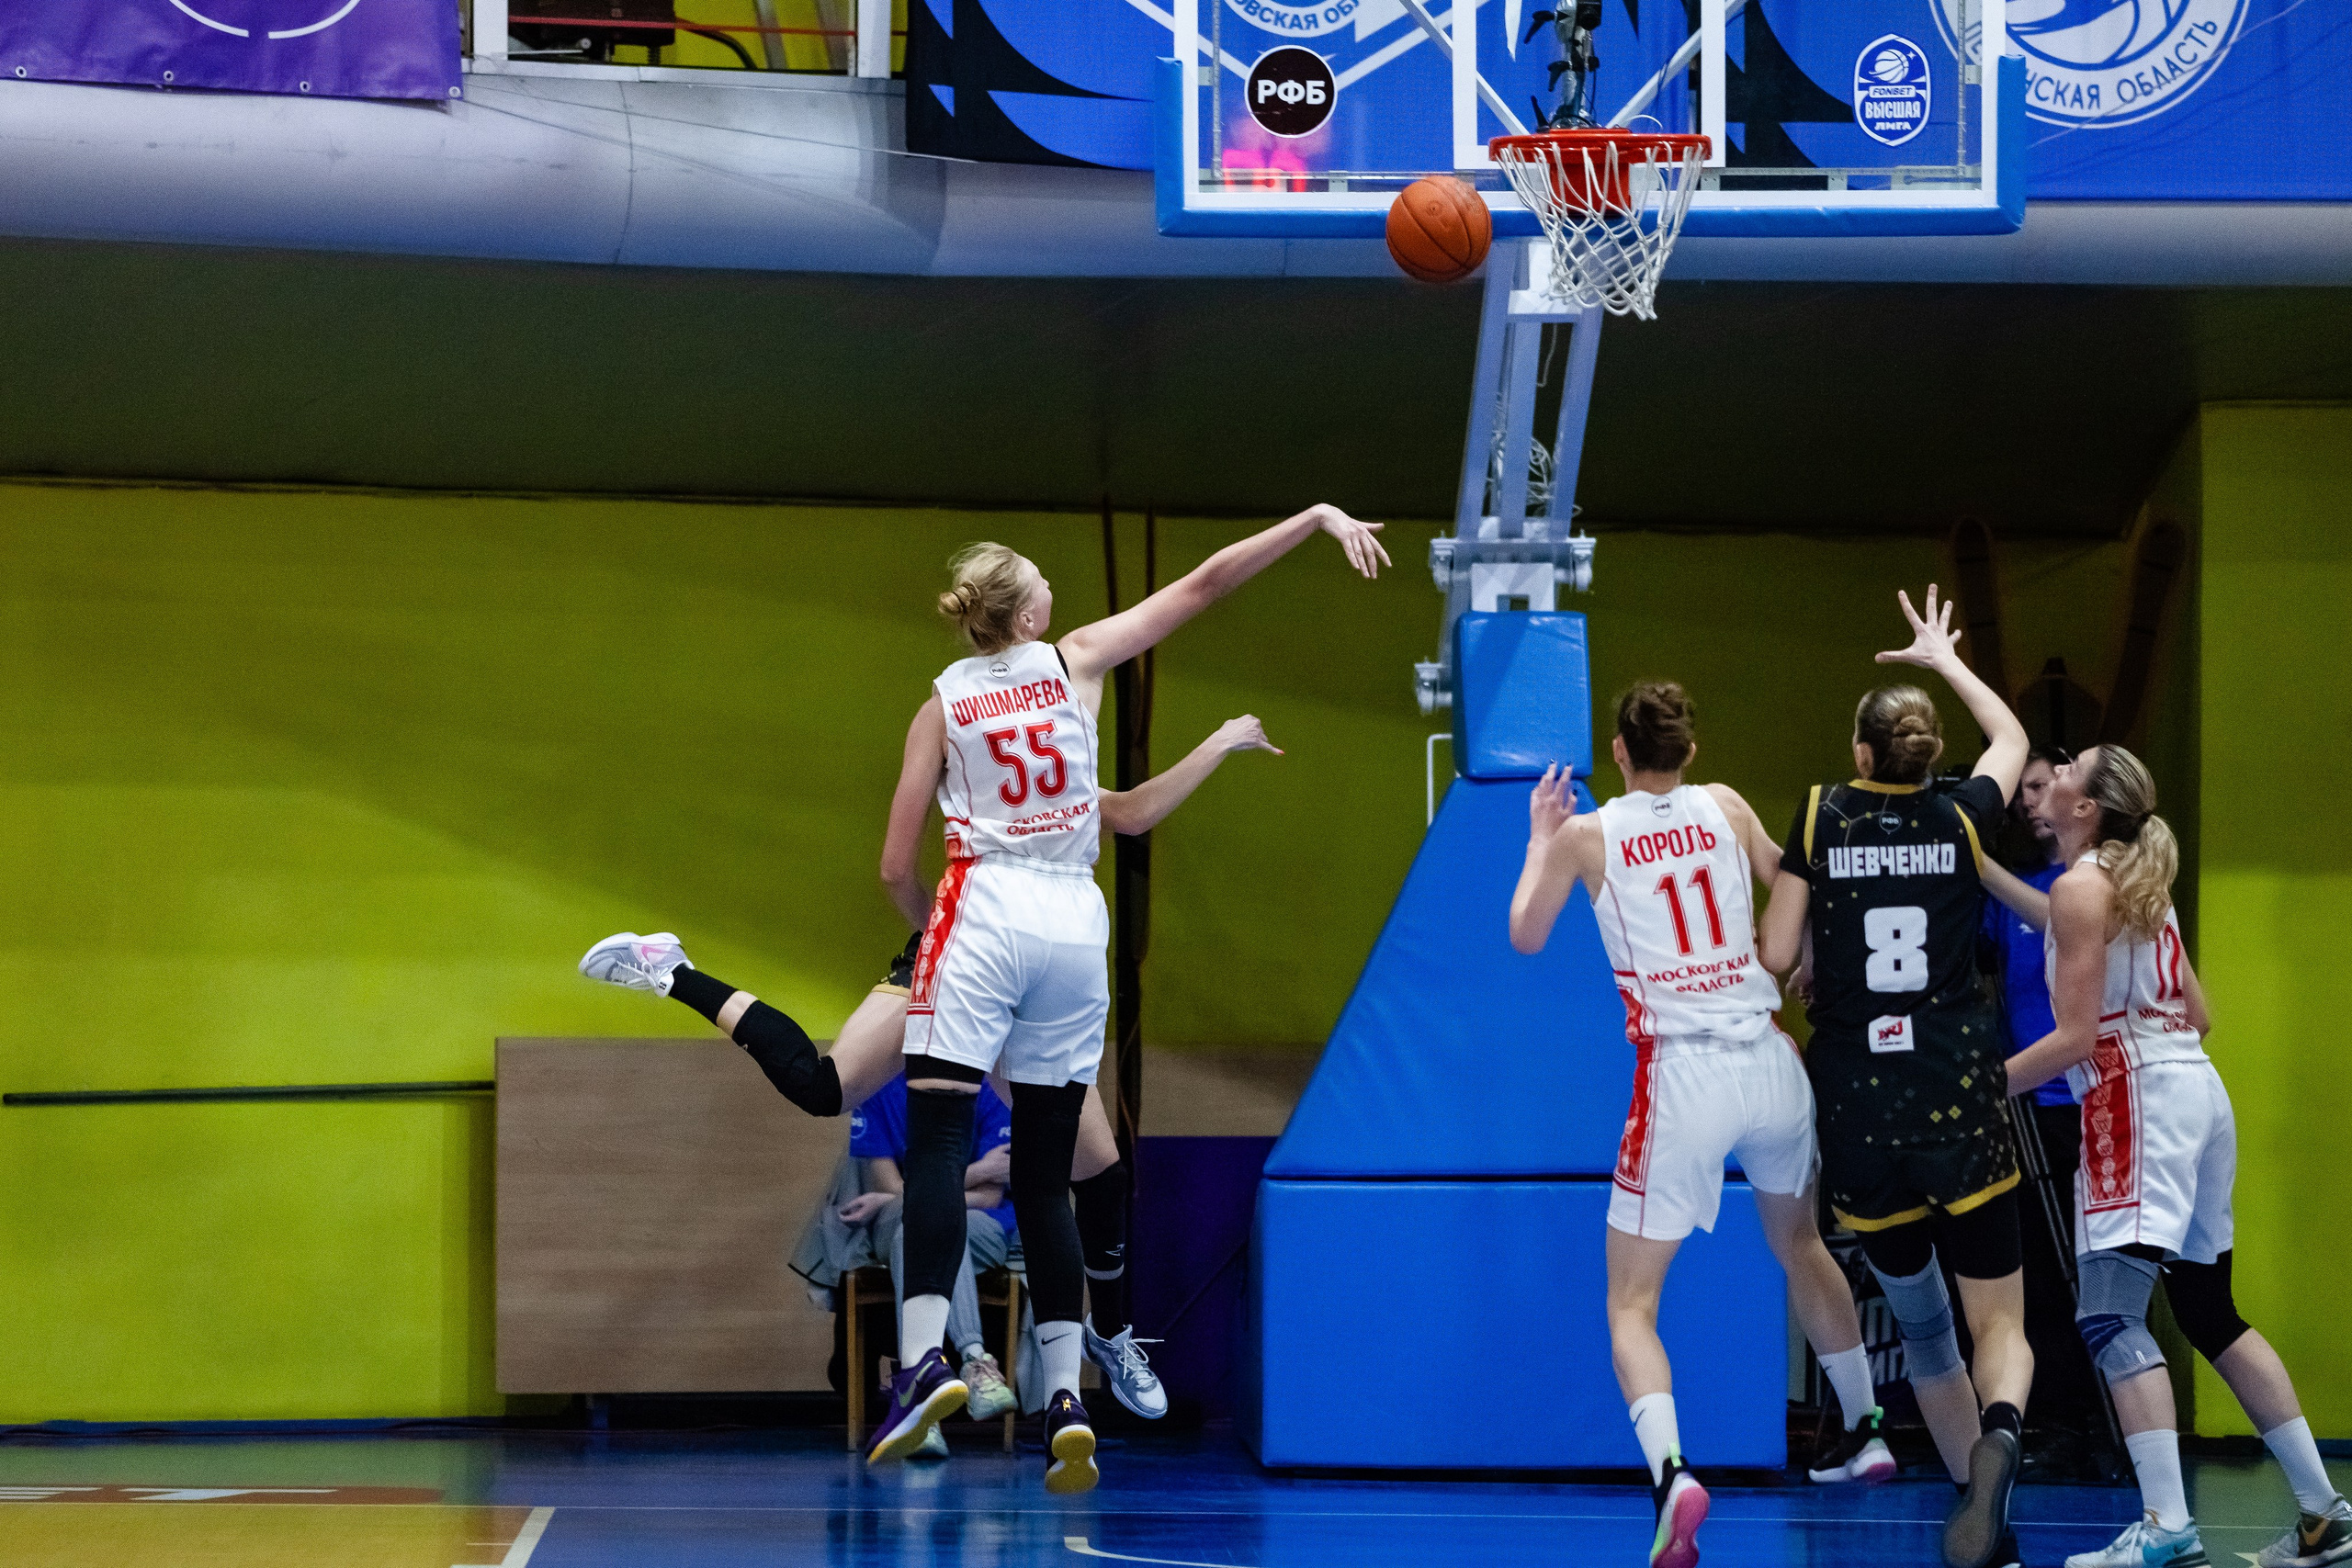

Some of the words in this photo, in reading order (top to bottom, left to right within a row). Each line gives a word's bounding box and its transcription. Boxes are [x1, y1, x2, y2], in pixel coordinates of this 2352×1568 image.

[2116, 20, 2219, 104] ОБЛАСТЬ
[1257, 79, 1327, 105] РФБ
[1864, 100, 1921, 119] ВЫСШАЯ
[1872, 87, 1913, 96] FONBET
[1874, 121, 1912, 131] ЛИГА
[952, 677, 1069, 728] ШИШМАРЕВА
[983, 719, 1069, 808] 55
[1620, 823, 1717, 868] КОРОЛЬ
[1827, 842, 1956, 879] ШЕВЧЕНКО
[1653, 863, 1727, 957] 11
[1863, 906, 1928, 993] 8
